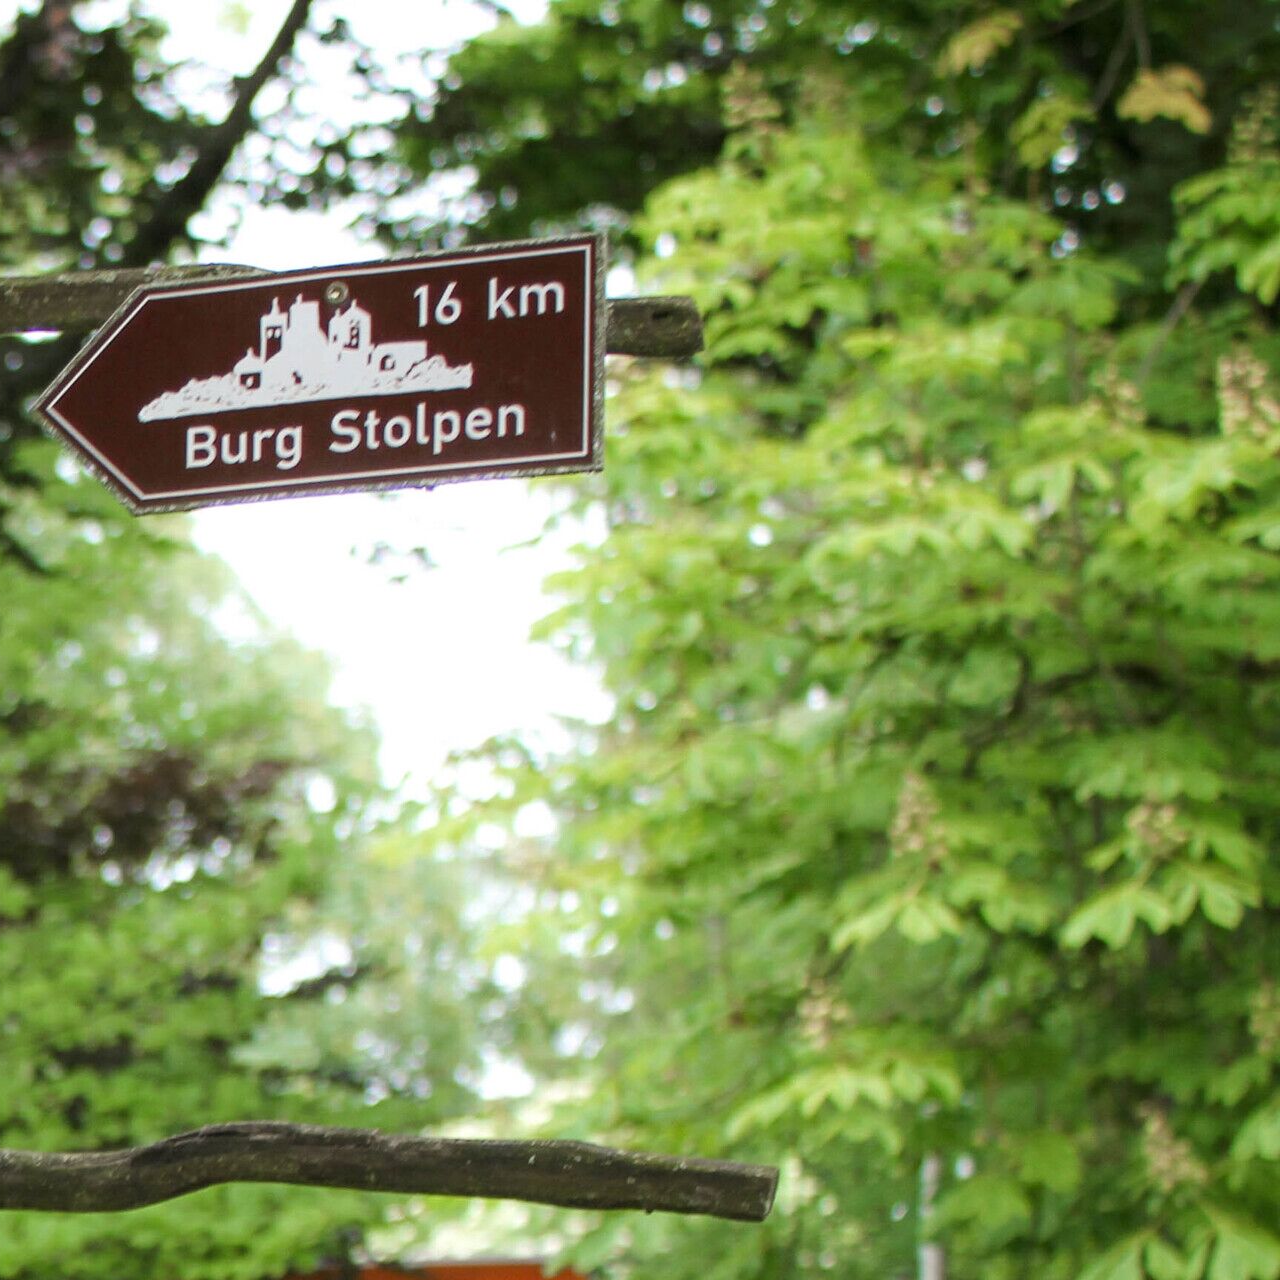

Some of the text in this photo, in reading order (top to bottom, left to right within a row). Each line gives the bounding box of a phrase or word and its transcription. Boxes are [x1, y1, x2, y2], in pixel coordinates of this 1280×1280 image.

[413, 277, 565, 327] 16 km
[186, 401, 525, 470] Burg Stolpen
